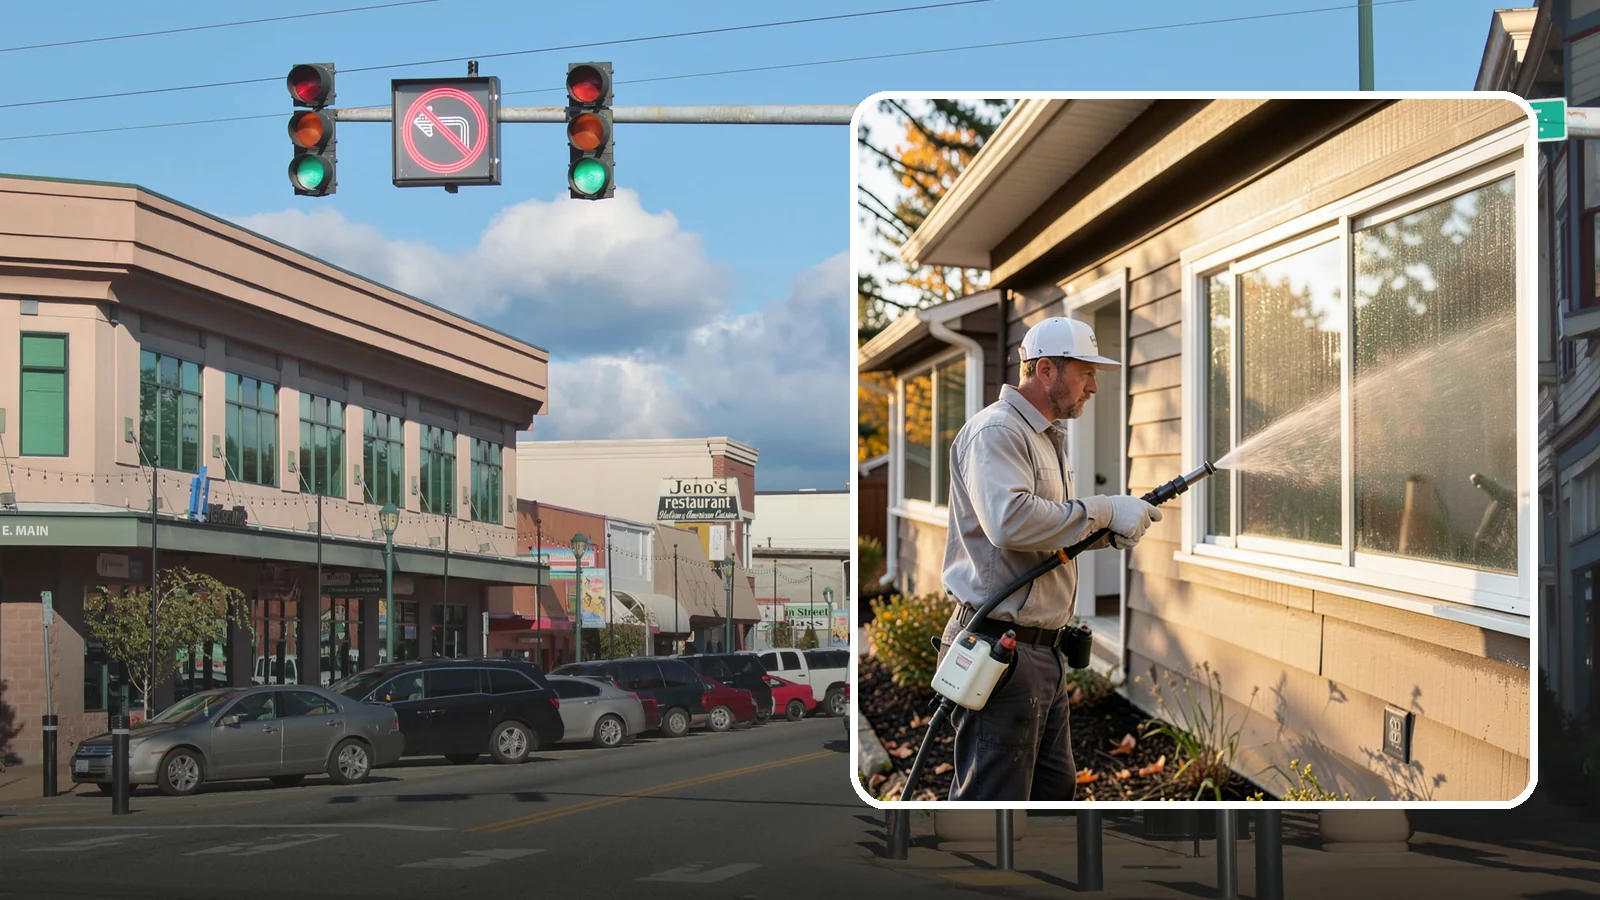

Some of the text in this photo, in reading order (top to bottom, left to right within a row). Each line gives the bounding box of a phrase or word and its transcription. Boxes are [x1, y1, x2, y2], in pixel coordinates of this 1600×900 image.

[670, 480, 727, 494] Jeno's
[665, 496, 731, 509] restaurant
[659, 510, 681, 519] Italian
[686, 510, 714, 519] American
[715, 510, 737, 519] Cuisine
[2, 525, 49, 536] E. MAIN
[797, 607, 828, 617] Street
[791, 619, 824, 627] lass
